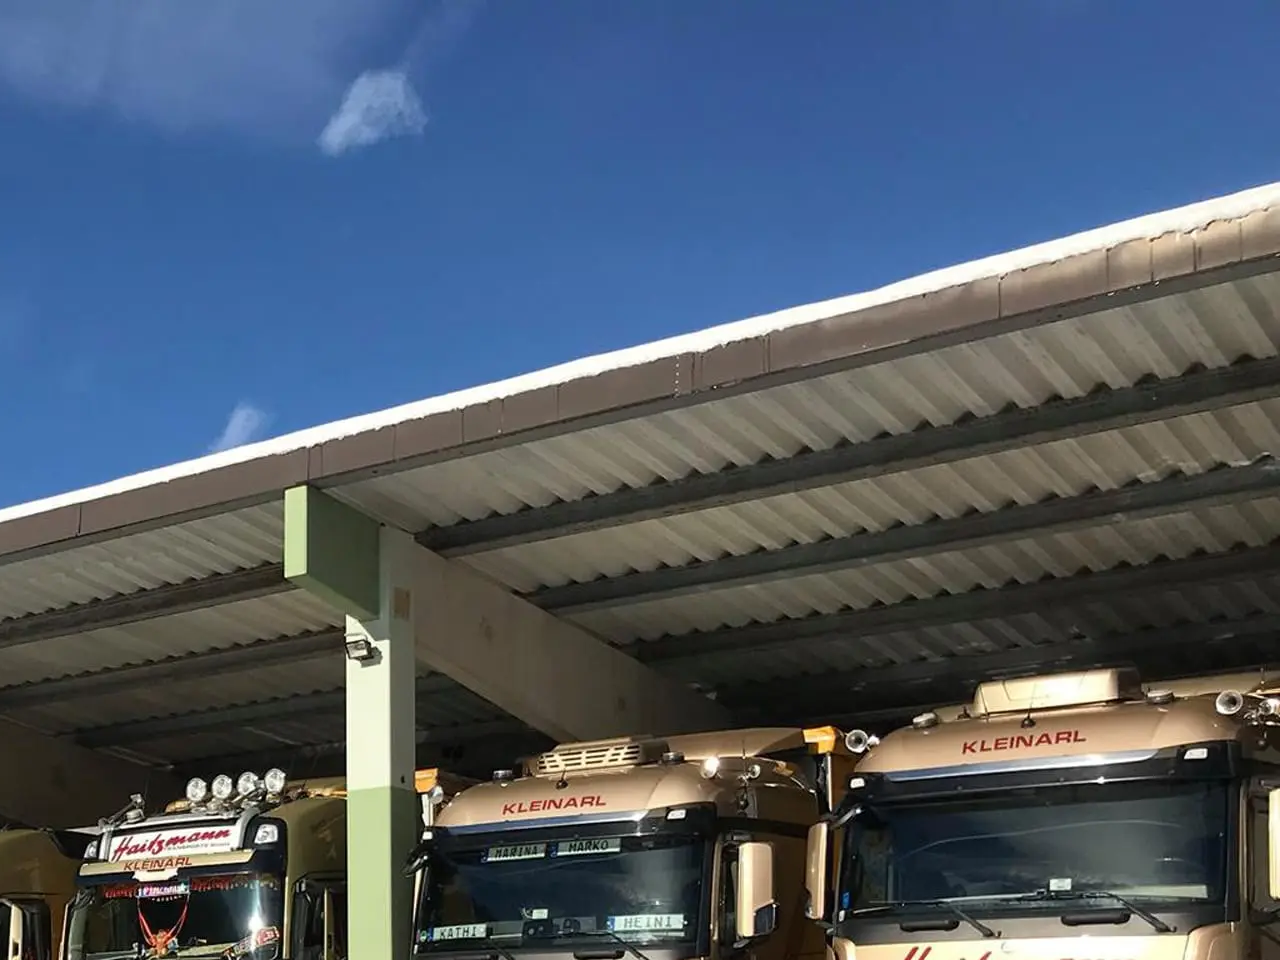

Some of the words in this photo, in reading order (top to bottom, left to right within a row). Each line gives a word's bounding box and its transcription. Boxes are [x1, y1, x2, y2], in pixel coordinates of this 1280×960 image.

[962, 730, 1087, 755] KLEINARL
[502, 796, 606, 815] KLEINARL
[112, 829, 232, 862] Haitzmann
[494, 846, 538, 858] MARINA
[569, 840, 609, 852] MARKO
[124, 857, 192, 871] KLEINARL
[624, 916, 672, 928] HEINI
[440, 927, 477, 939] KATHI
